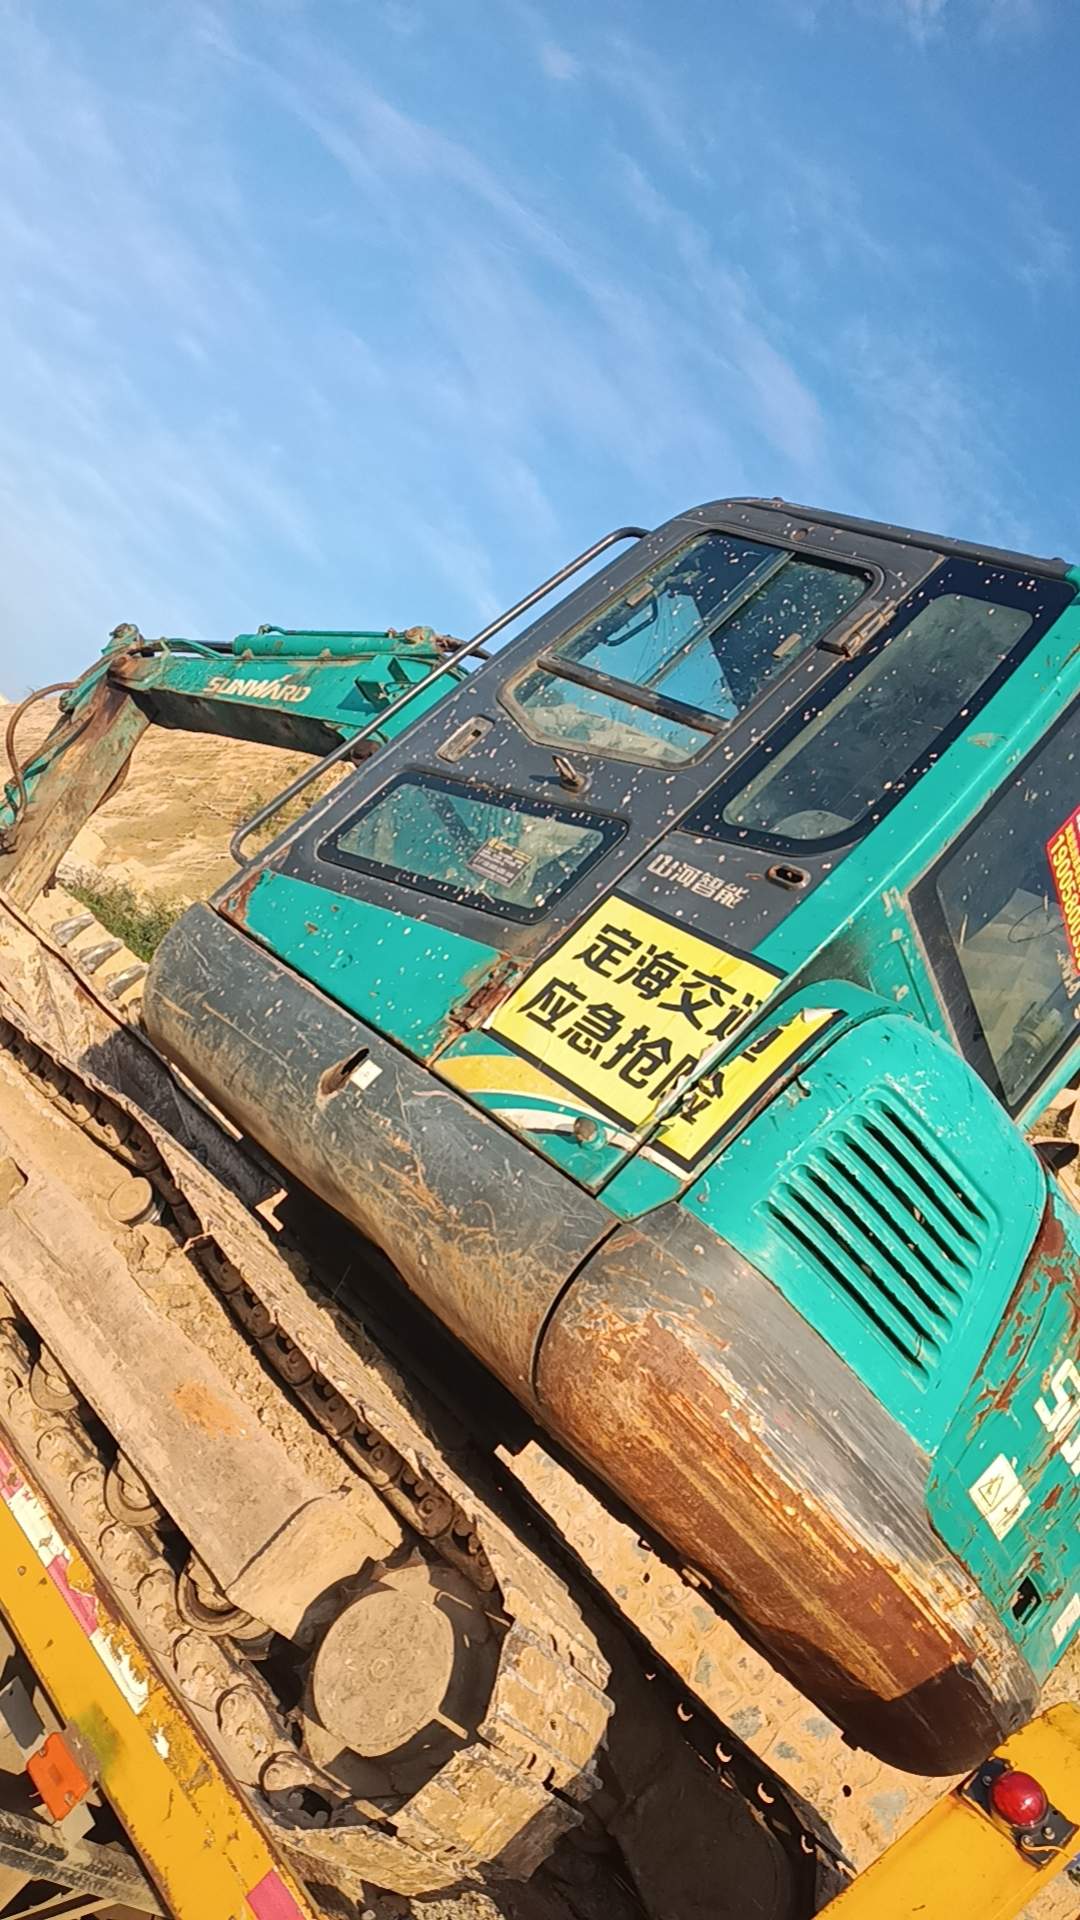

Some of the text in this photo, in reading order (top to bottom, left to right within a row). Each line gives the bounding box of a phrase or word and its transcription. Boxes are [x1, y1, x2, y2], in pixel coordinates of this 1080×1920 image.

[203, 675, 311, 702] SUNWARD
[647, 854, 749, 909] 山河智能
